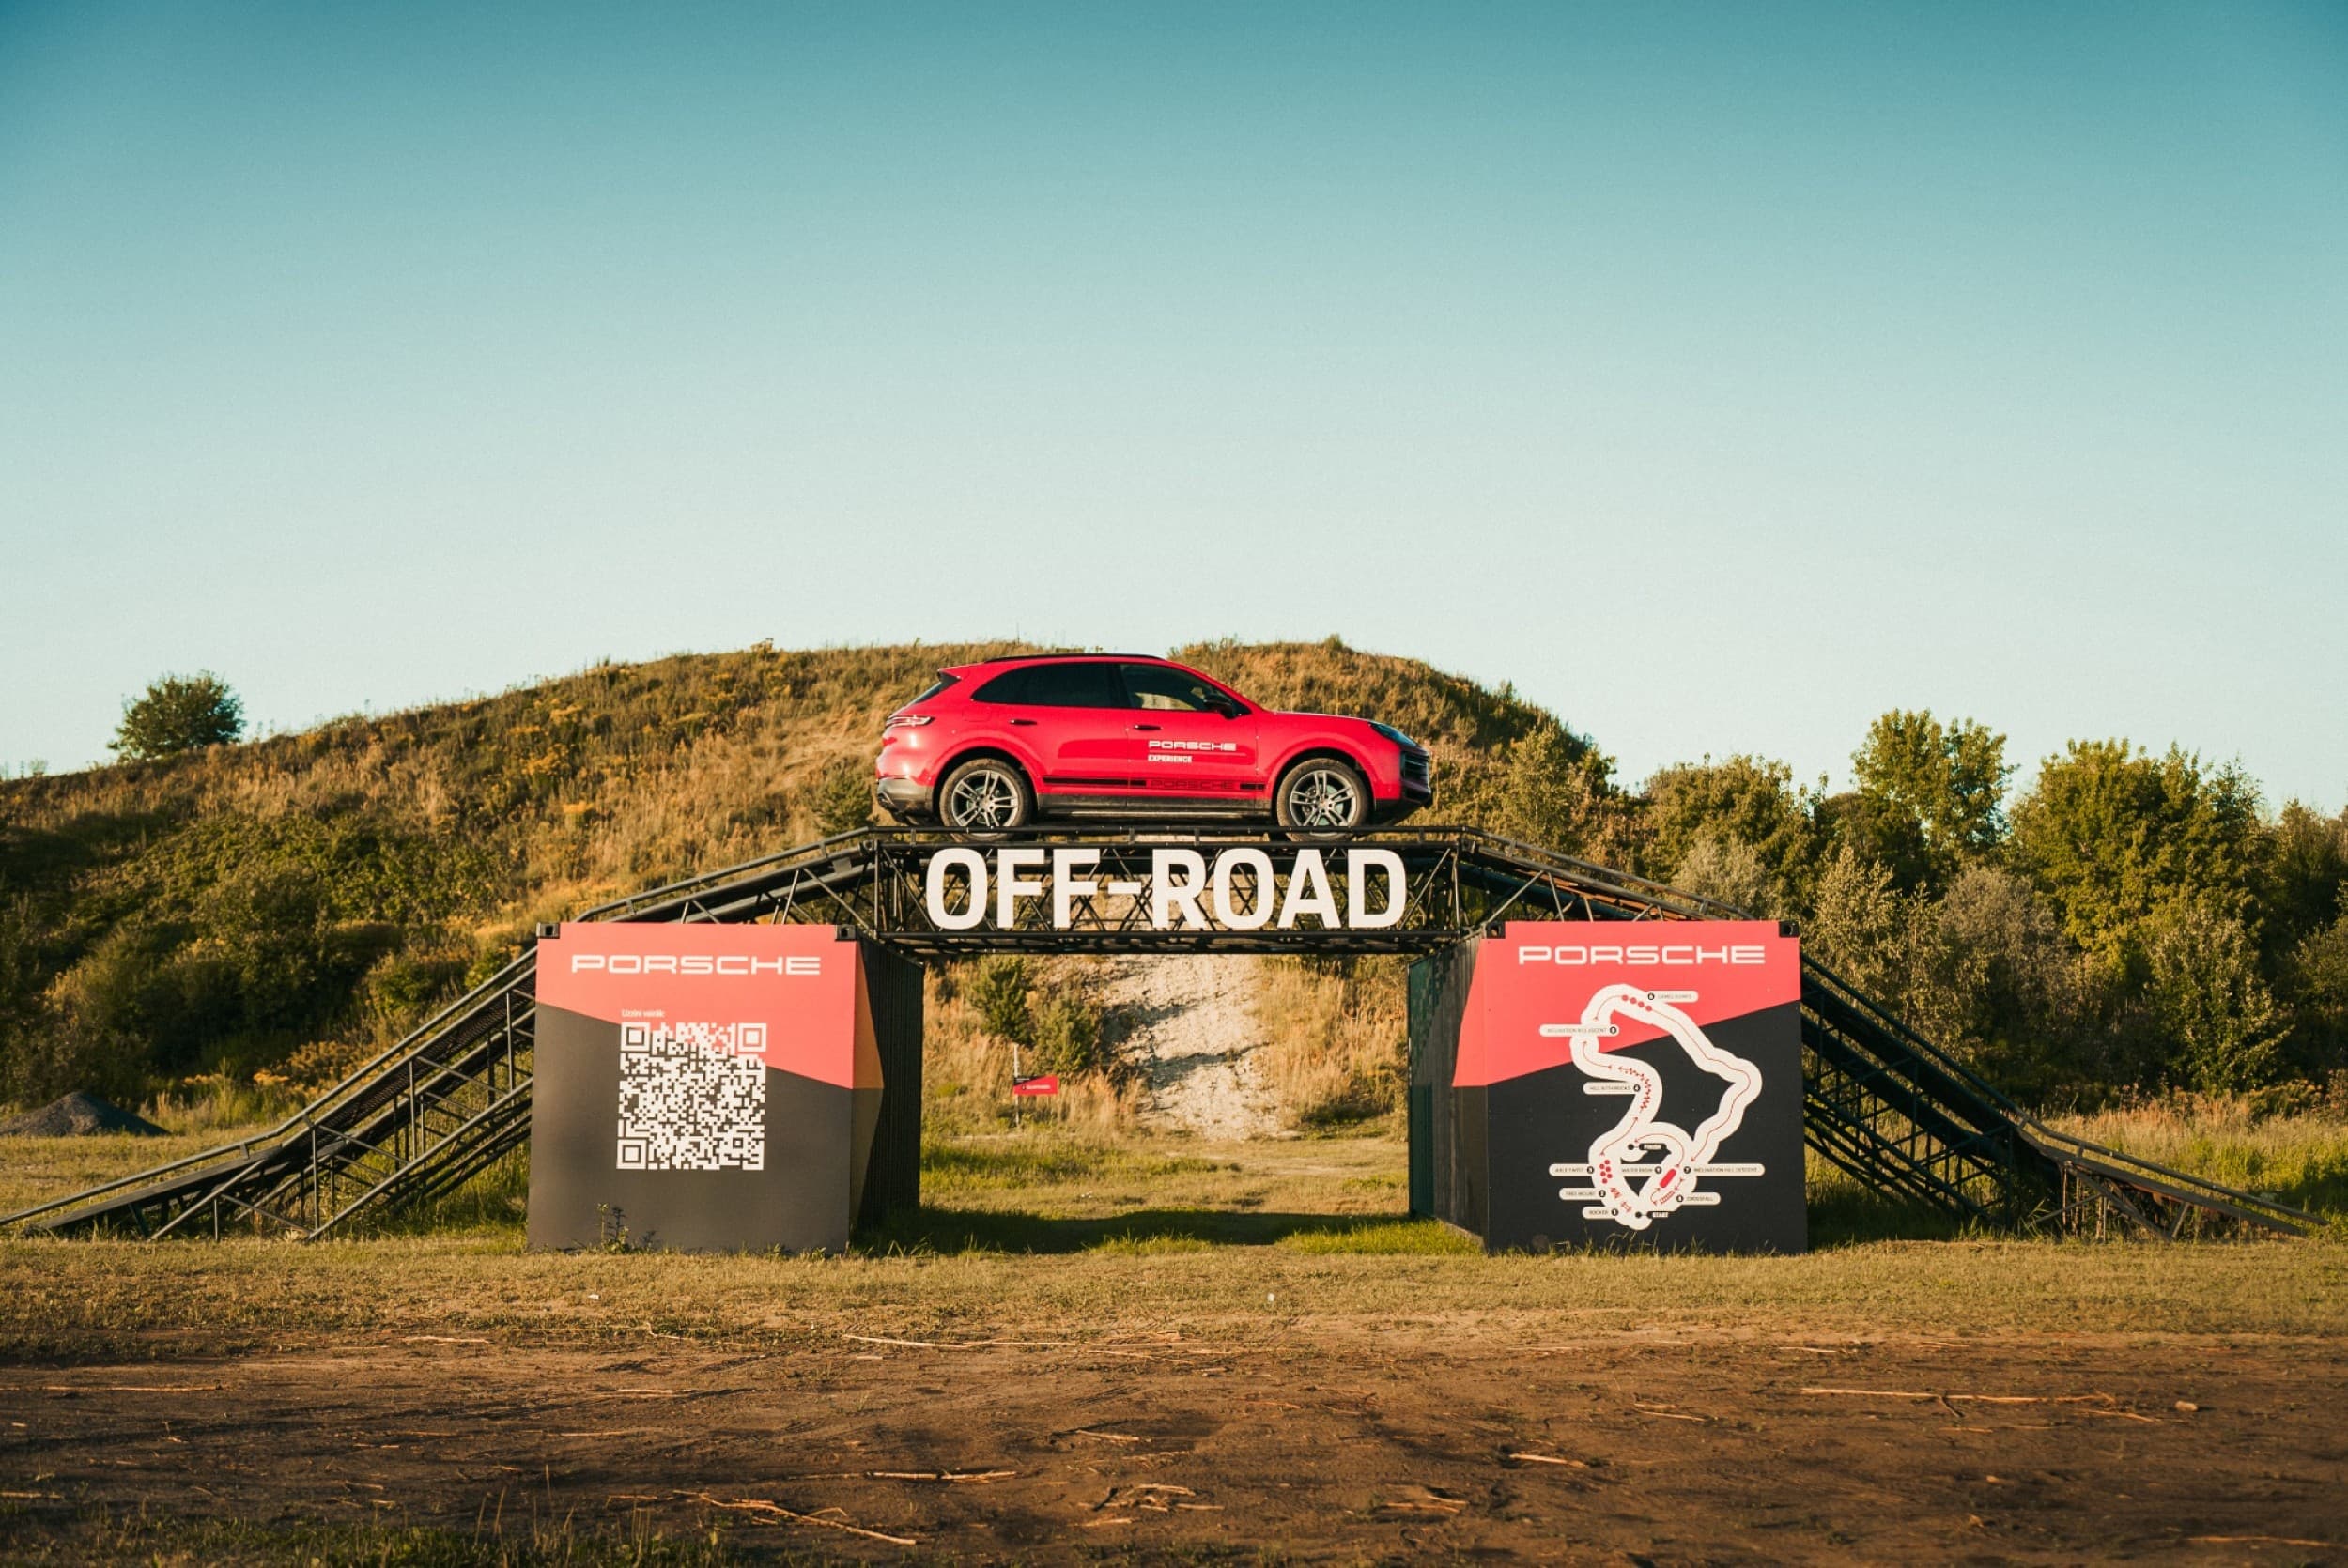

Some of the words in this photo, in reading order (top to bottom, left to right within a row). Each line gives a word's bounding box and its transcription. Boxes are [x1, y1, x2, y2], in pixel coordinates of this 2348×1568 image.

[1148, 740, 1237, 752] PORSCHE
[1147, 754, 1193, 763] EXPERIENCE
[1151, 779, 1235, 790] PORSCHE
[925, 847, 1408, 931] OFF-ROAD
[1518, 945, 1767, 965] PORSCHE
[571, 954, 822, 976] PORSCHE
